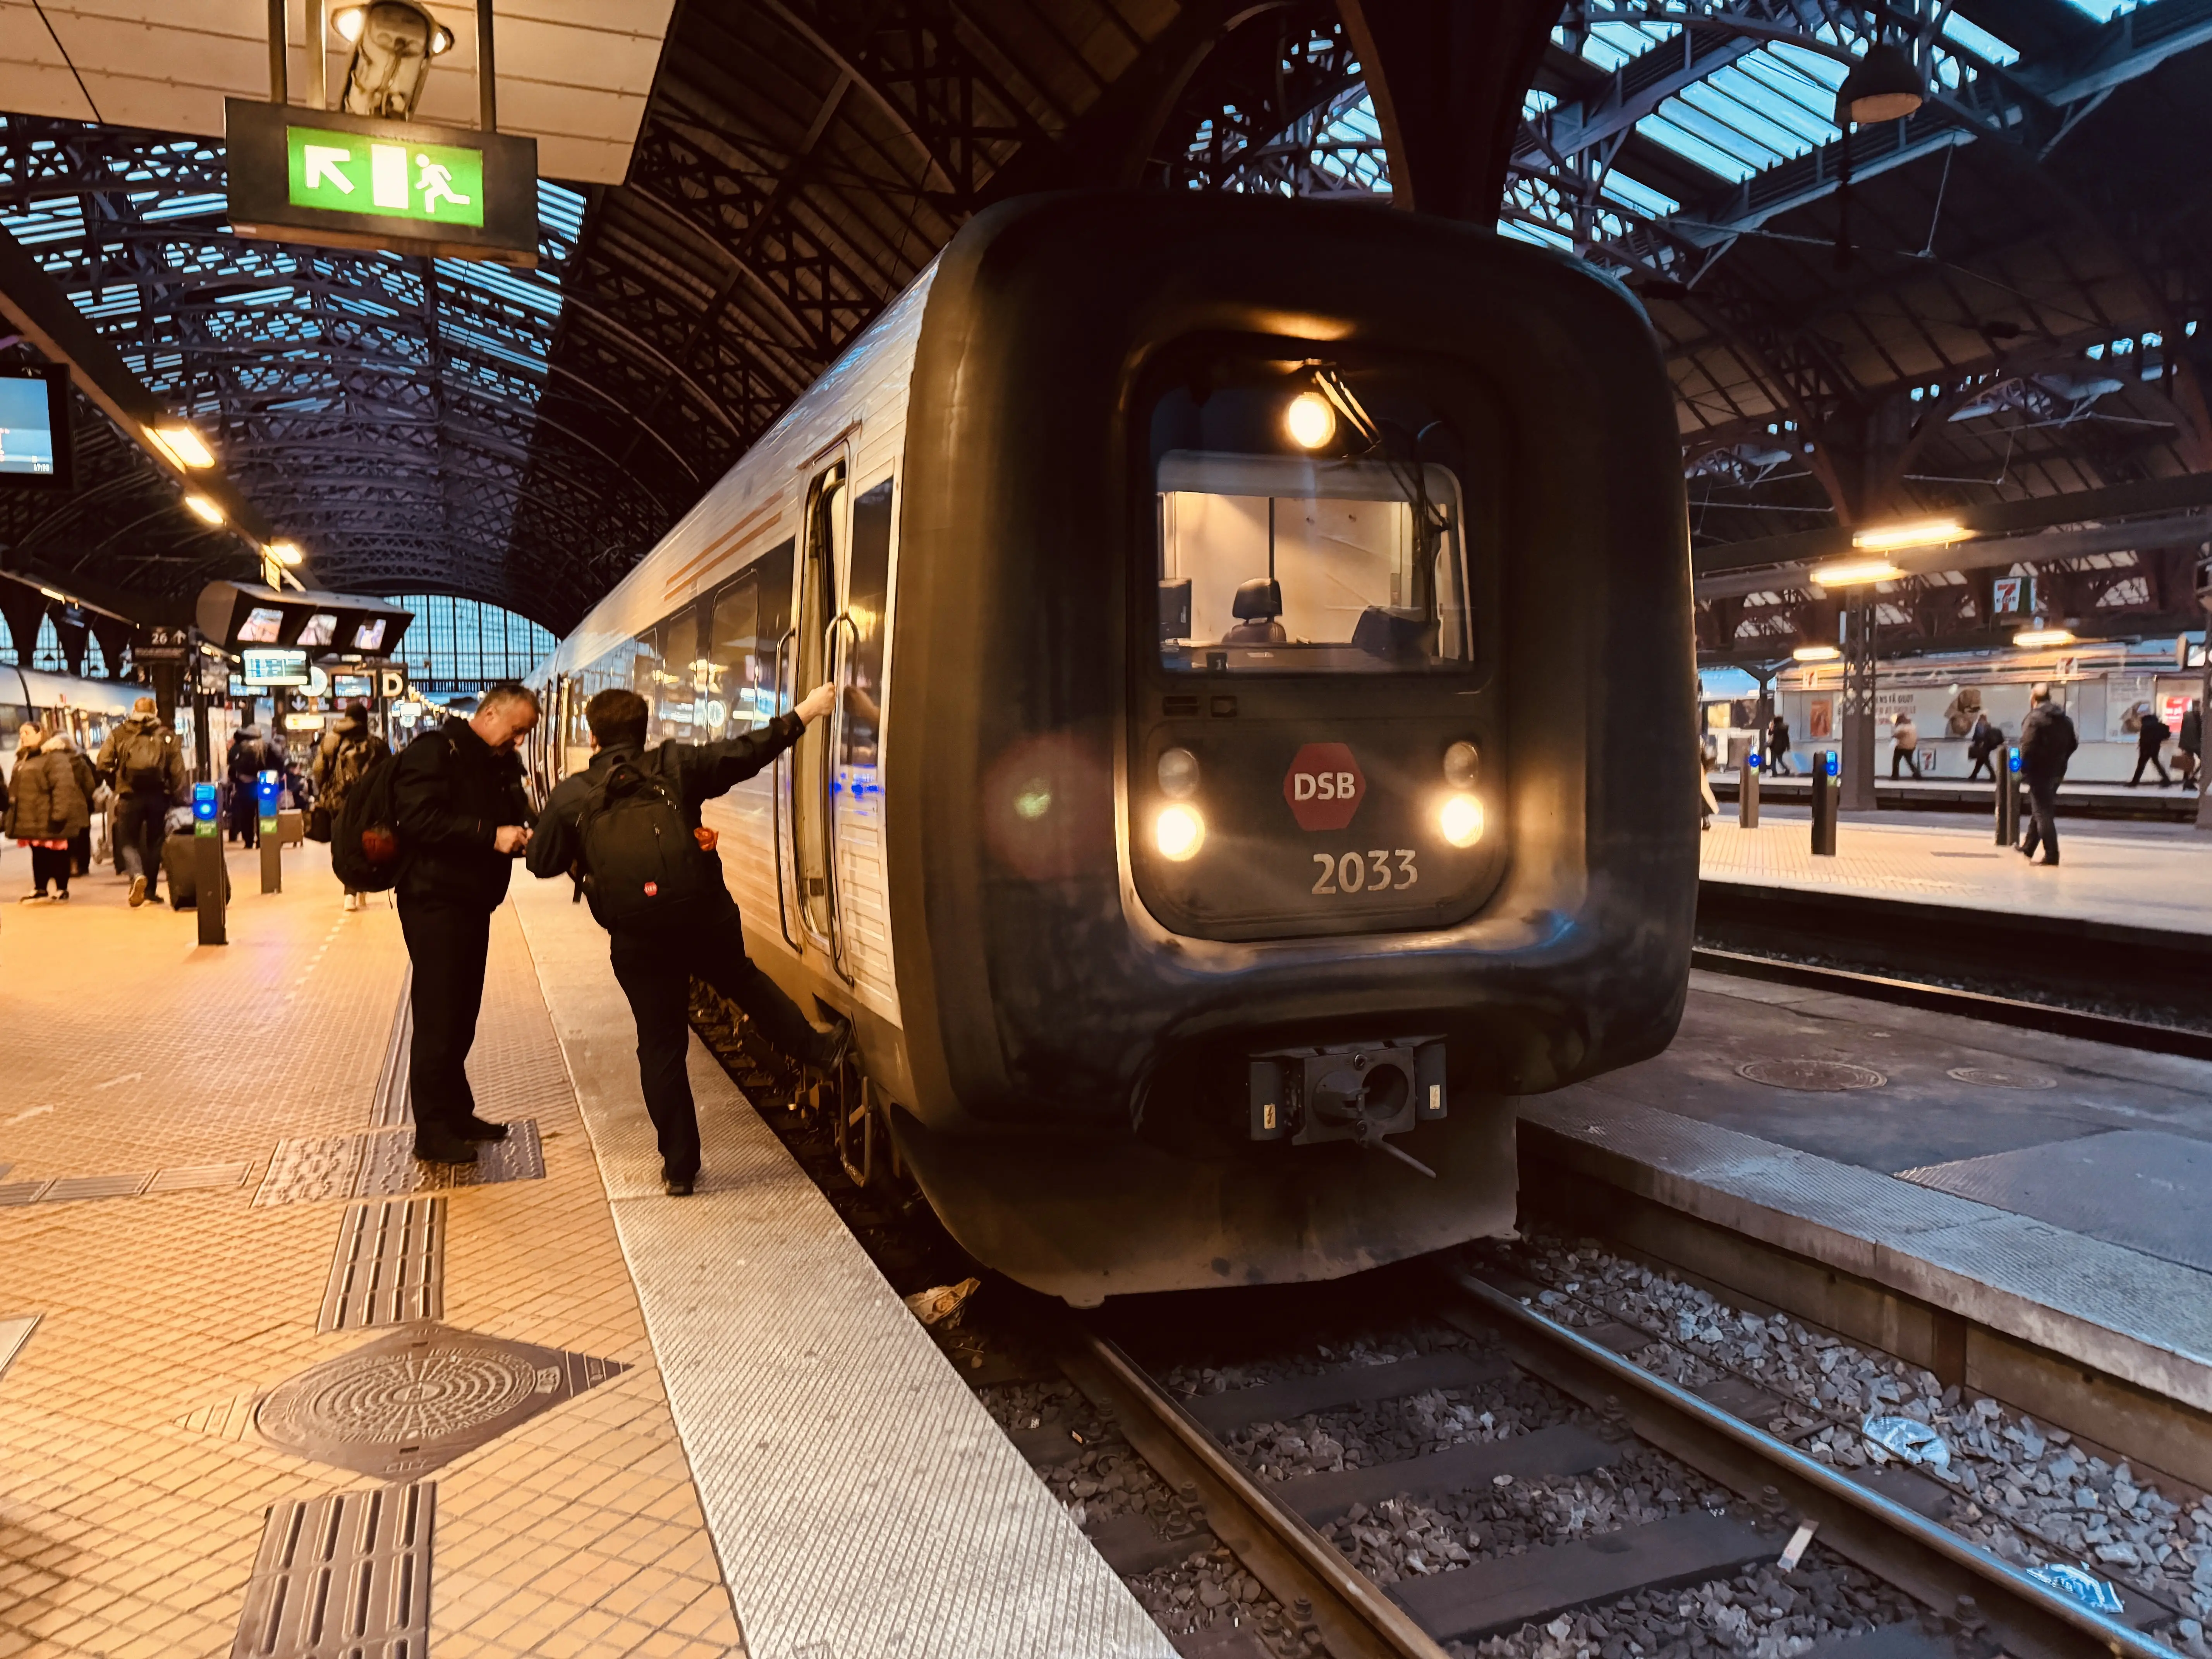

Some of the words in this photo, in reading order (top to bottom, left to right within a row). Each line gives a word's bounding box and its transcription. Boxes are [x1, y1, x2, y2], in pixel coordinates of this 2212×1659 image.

[151, 632, 168, 645] 26
[383, 673, 403, 697] D
[1294, 772, 1355, 800] DSB
[1311, 849, 1418, 895] 2033
